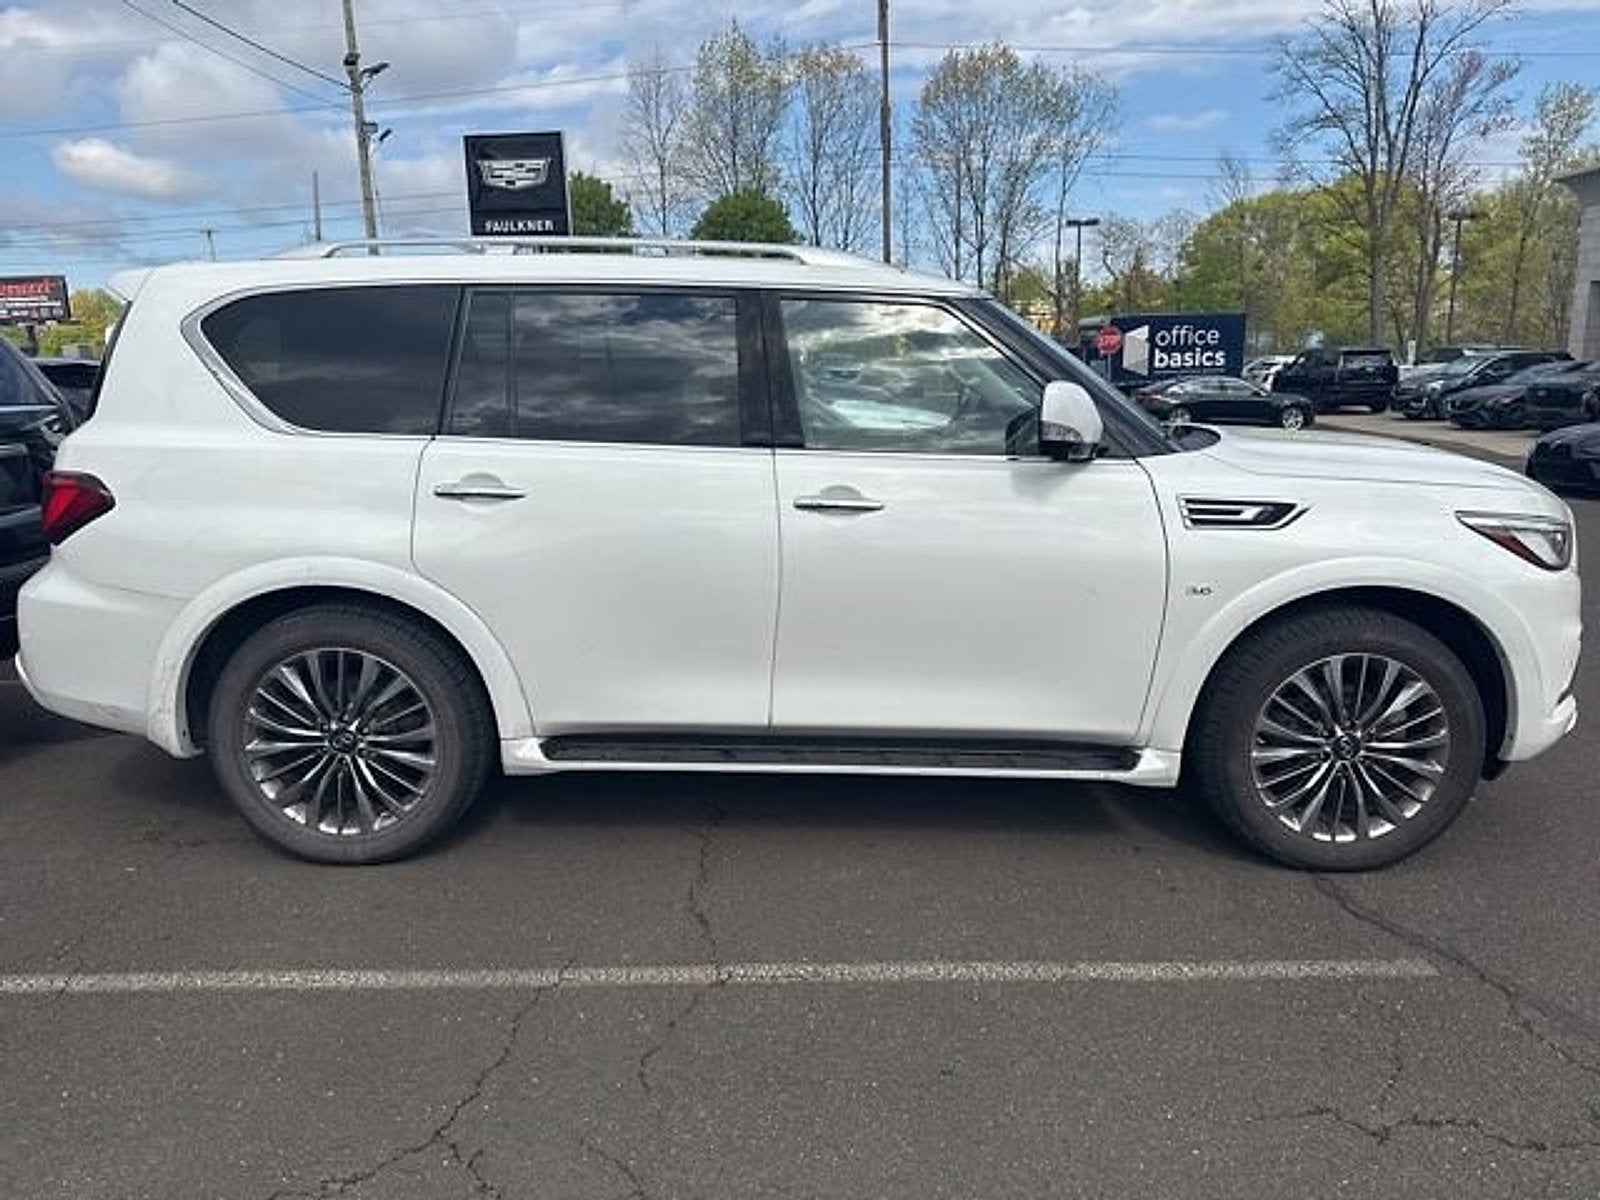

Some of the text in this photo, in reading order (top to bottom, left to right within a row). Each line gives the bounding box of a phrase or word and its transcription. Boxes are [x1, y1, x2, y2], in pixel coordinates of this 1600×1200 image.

[485, 220, 554, 232] FAULKNER
[1155, 325, 1220, 346] office
[1154, 348, 1226, 368] basics
